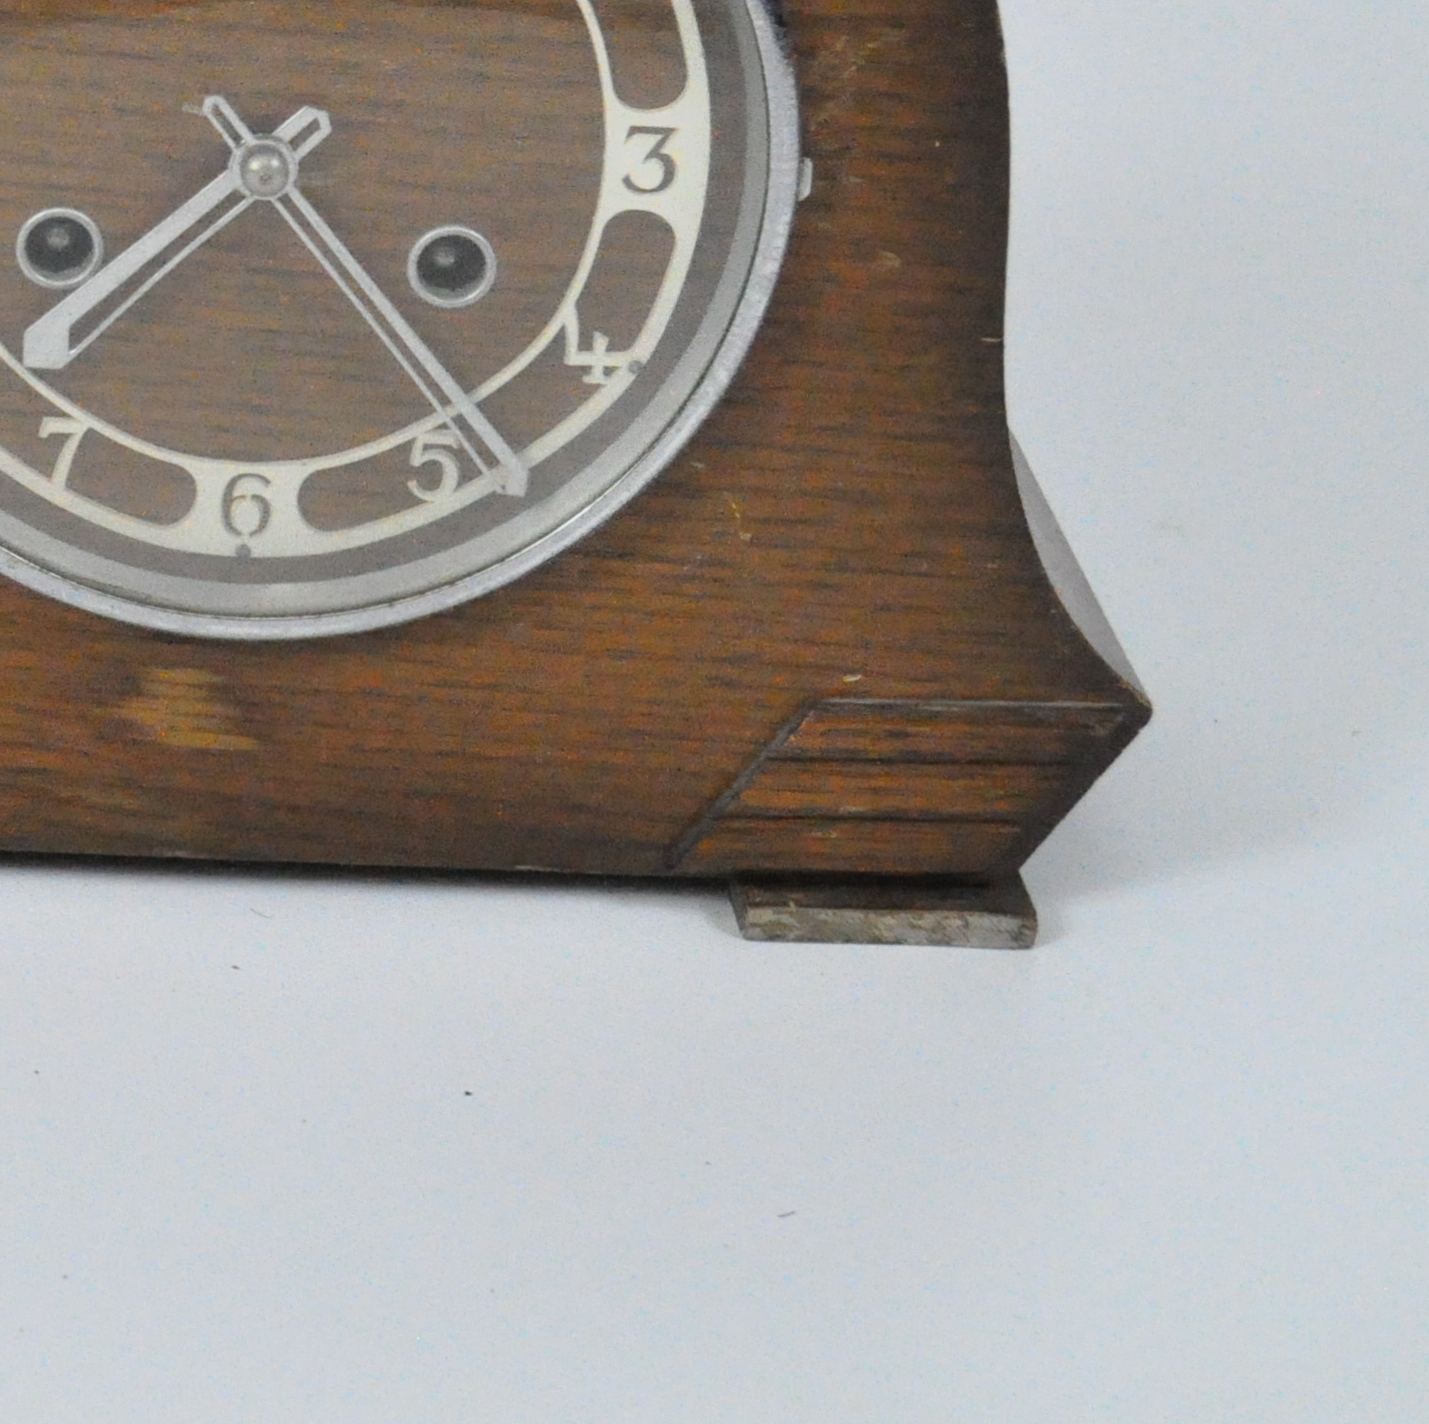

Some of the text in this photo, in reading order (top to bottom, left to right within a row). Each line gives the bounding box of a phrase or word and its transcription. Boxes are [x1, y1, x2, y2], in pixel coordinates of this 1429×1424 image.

[622, 125, 677, 193] 3
[563, 302, 641, 385] 4
[40, 417, 89, 490] 7
[407, 430, 463, 501] 5
[221, 473, 272, 538] 6
